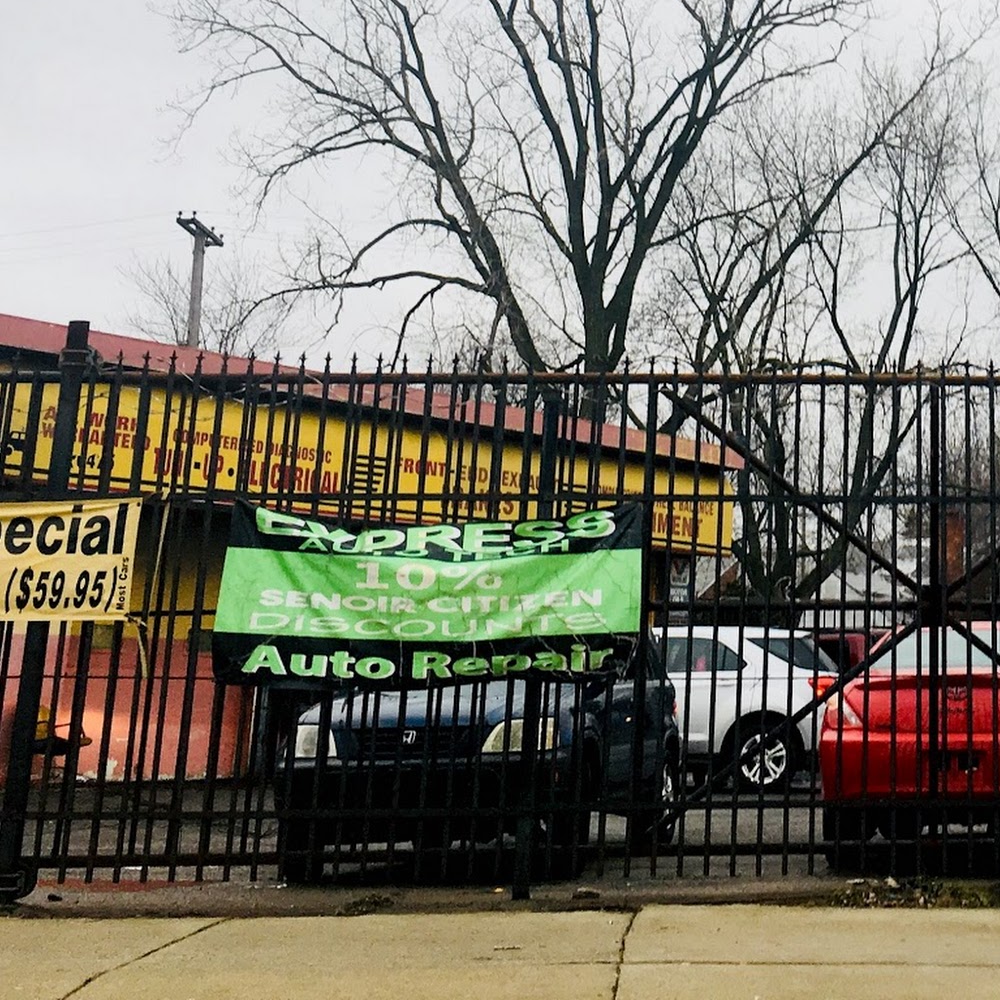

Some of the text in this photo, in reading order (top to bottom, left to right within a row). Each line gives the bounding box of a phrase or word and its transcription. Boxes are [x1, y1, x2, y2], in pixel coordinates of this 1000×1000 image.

[173, 428, 264, 454] COMPTERED
[0, 503, 129, 556] ecial
[5, 566, 117, 614] ($59.95)
[115, 557, 130, 610] Most Cars
[355, 561, 503, 591] 10%
[258, 589, 417, 614] SENOIR
[250, 611, 607, 638] DISCOUNTS
[241, 643, 614, 680] Auto Repair
